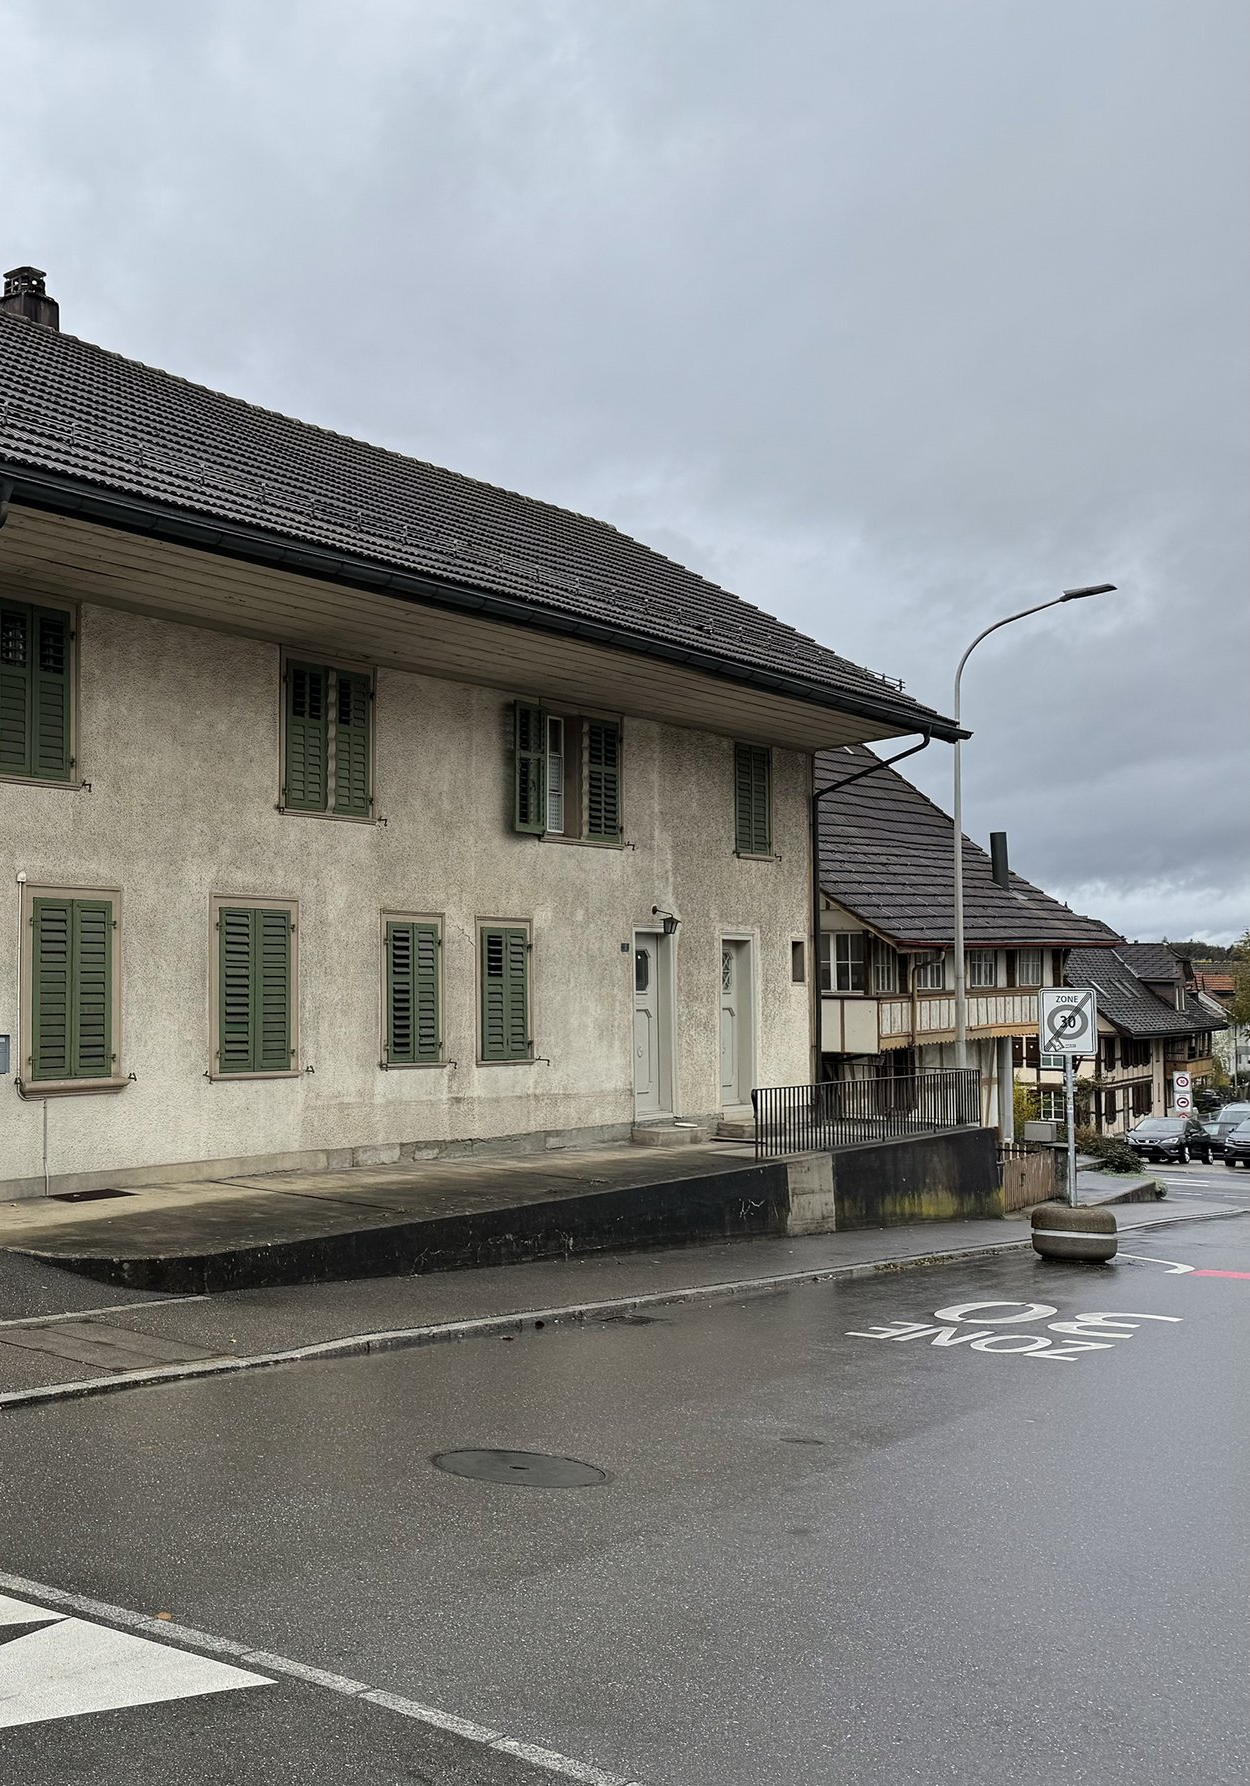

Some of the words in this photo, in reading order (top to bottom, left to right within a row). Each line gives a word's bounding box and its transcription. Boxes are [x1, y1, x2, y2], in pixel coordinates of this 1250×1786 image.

[1060, 1015, 1076, 1028] 30
[933, 1301, 1184, 1339] 30
[844, 1321, 1116, 1362] ZONE
